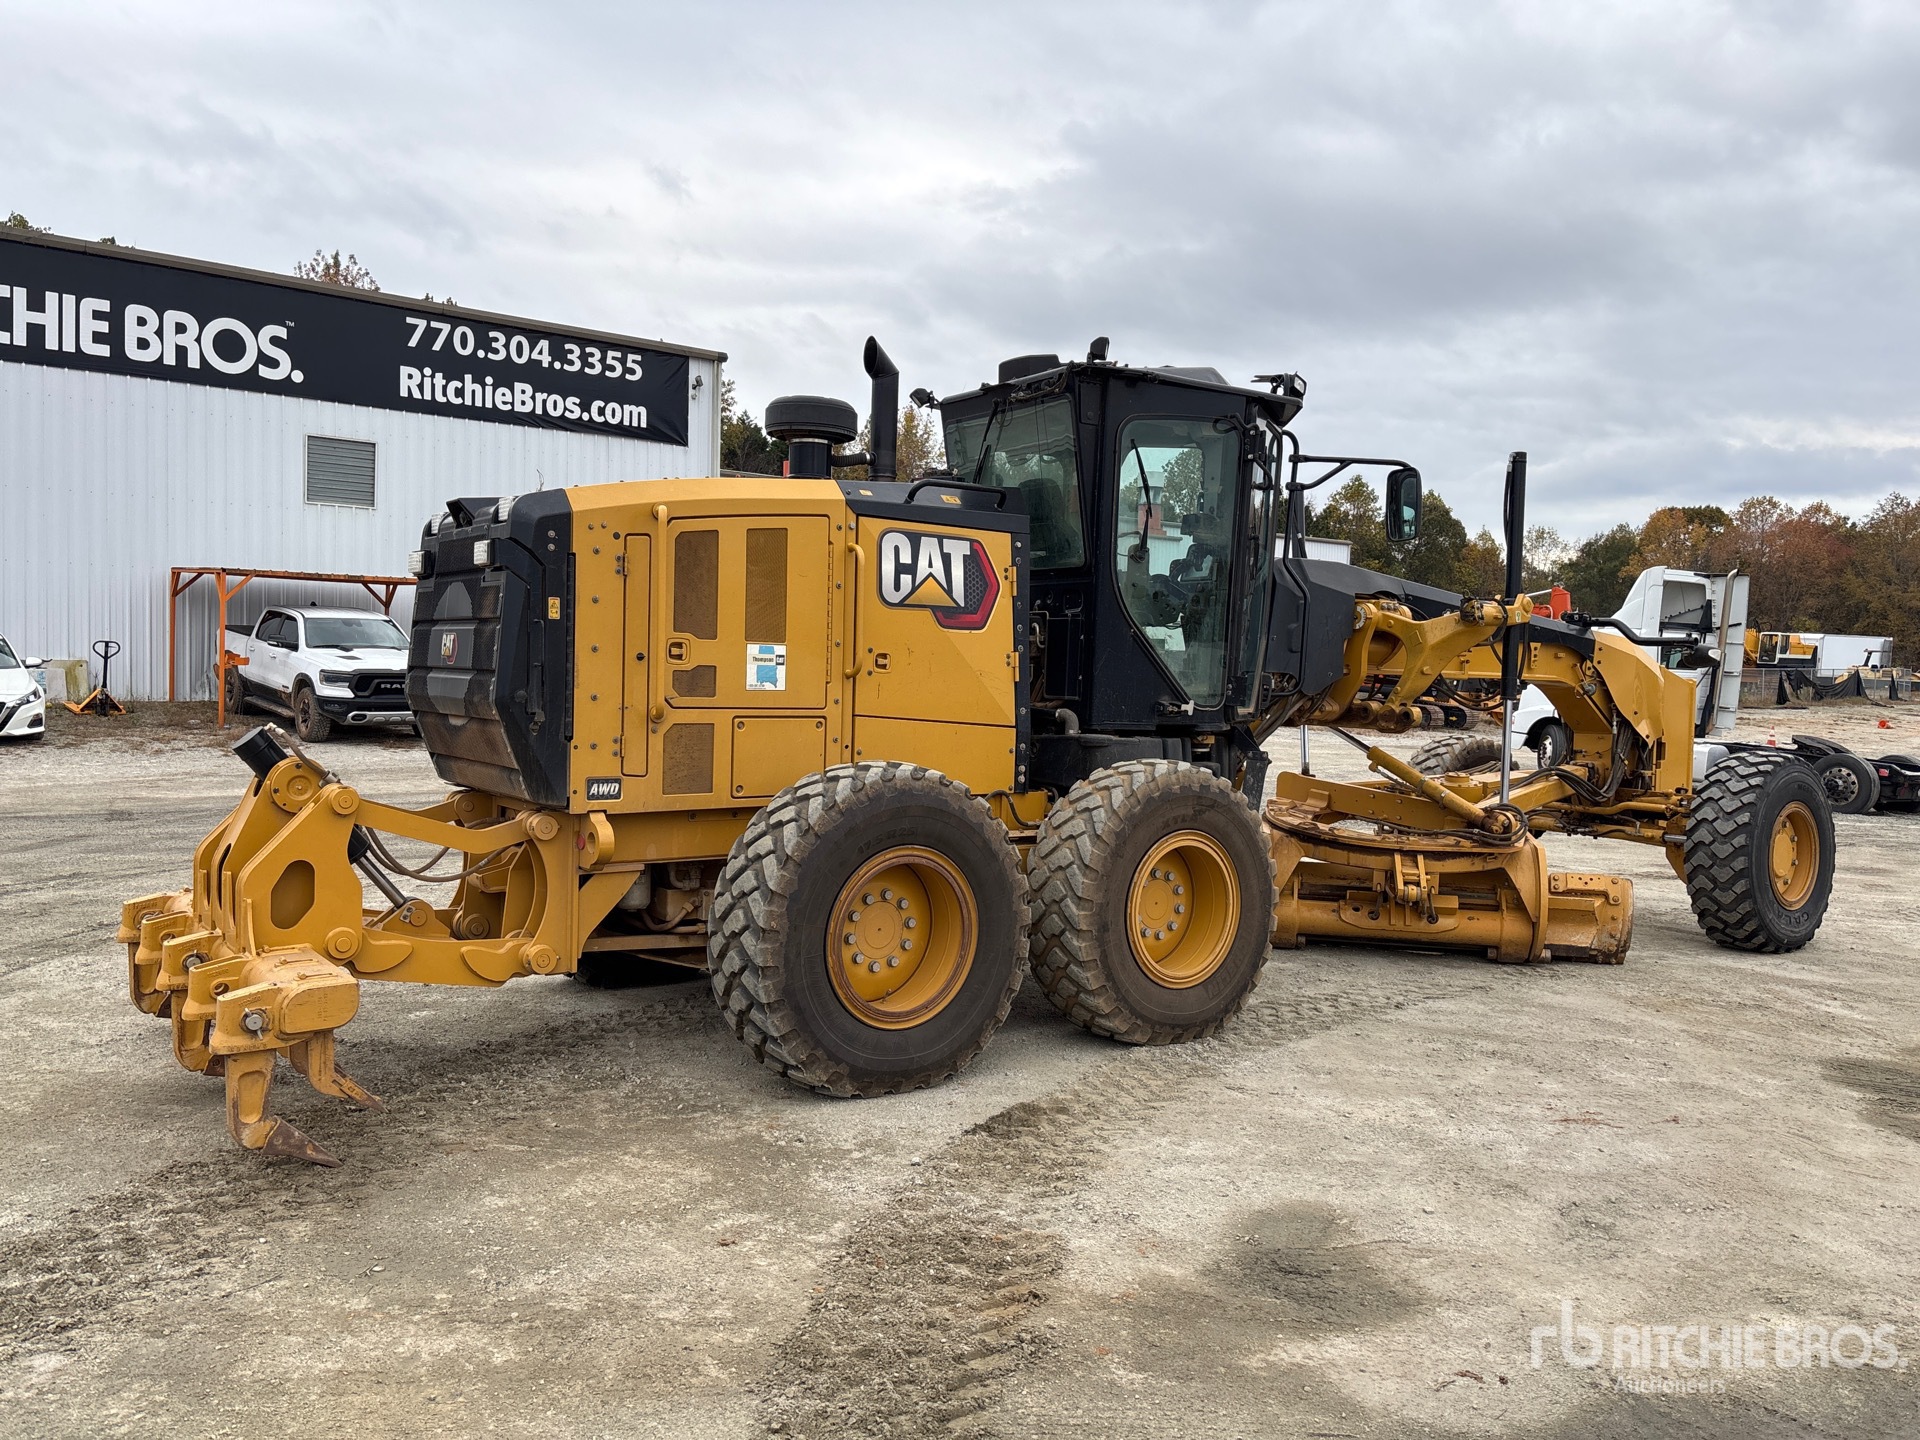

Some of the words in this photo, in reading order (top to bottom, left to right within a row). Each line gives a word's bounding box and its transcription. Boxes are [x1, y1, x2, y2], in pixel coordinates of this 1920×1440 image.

[0, 284, 110, 358] HIE
[124, 304, 304, 383] BROS.
[405, 316, 643, 382] 770.304.3355
[399, 365, 648, 428] RitchieBros.com
[881, 531, 971, 608] CAT
[441, 632, 455, 657] CAT
[588, 782, 620, 796] AWD
